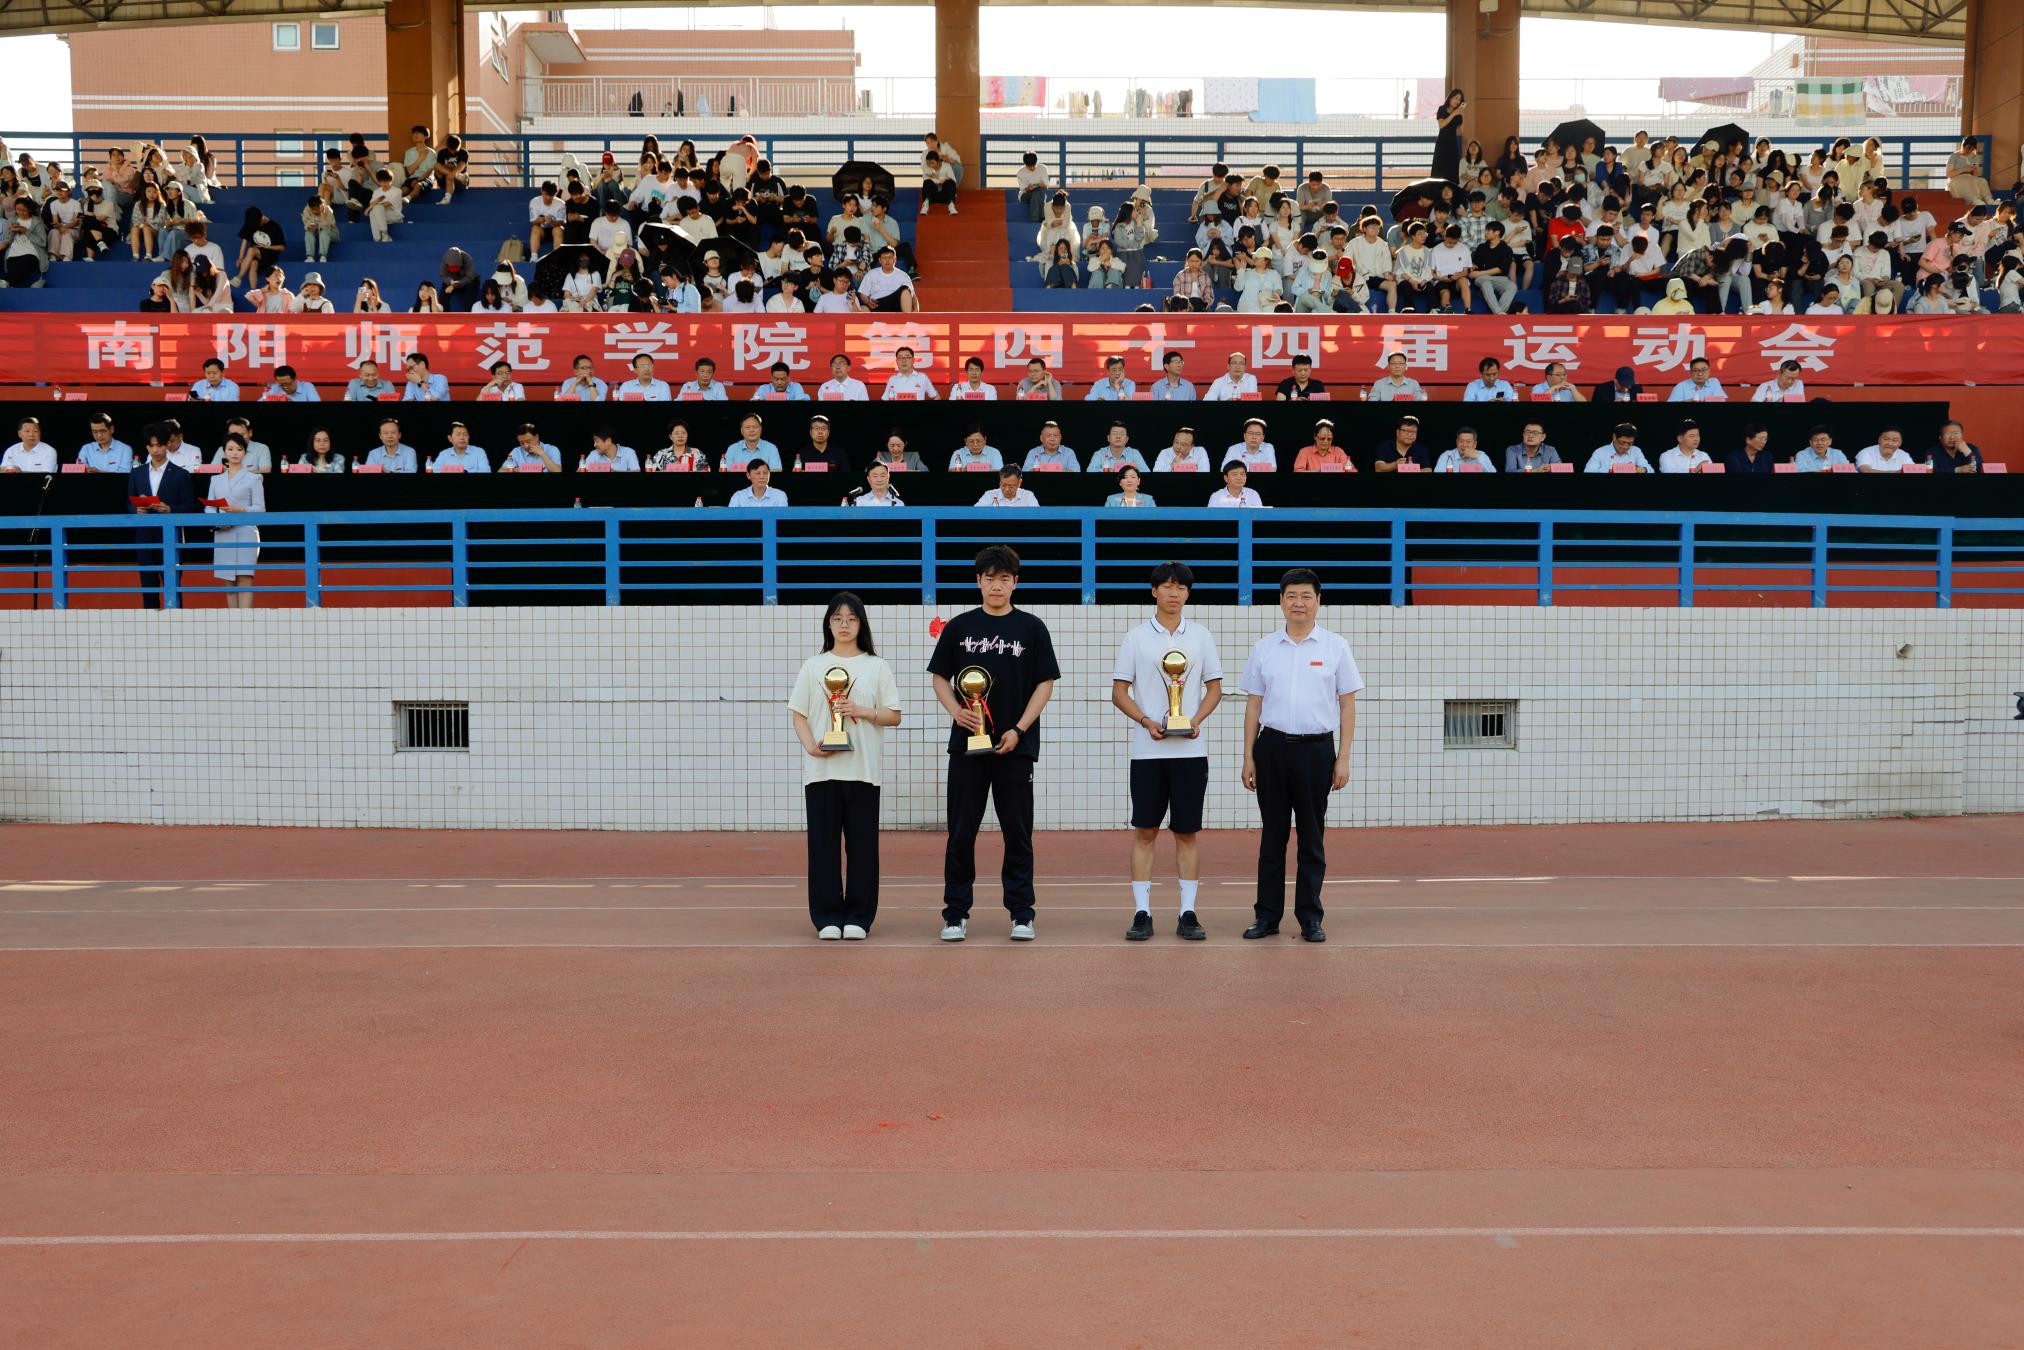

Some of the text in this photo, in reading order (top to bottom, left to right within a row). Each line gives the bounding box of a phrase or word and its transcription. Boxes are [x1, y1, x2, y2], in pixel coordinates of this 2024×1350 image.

[81, 320, 1837, 372] 南阳师范学院第四十四届运动会
